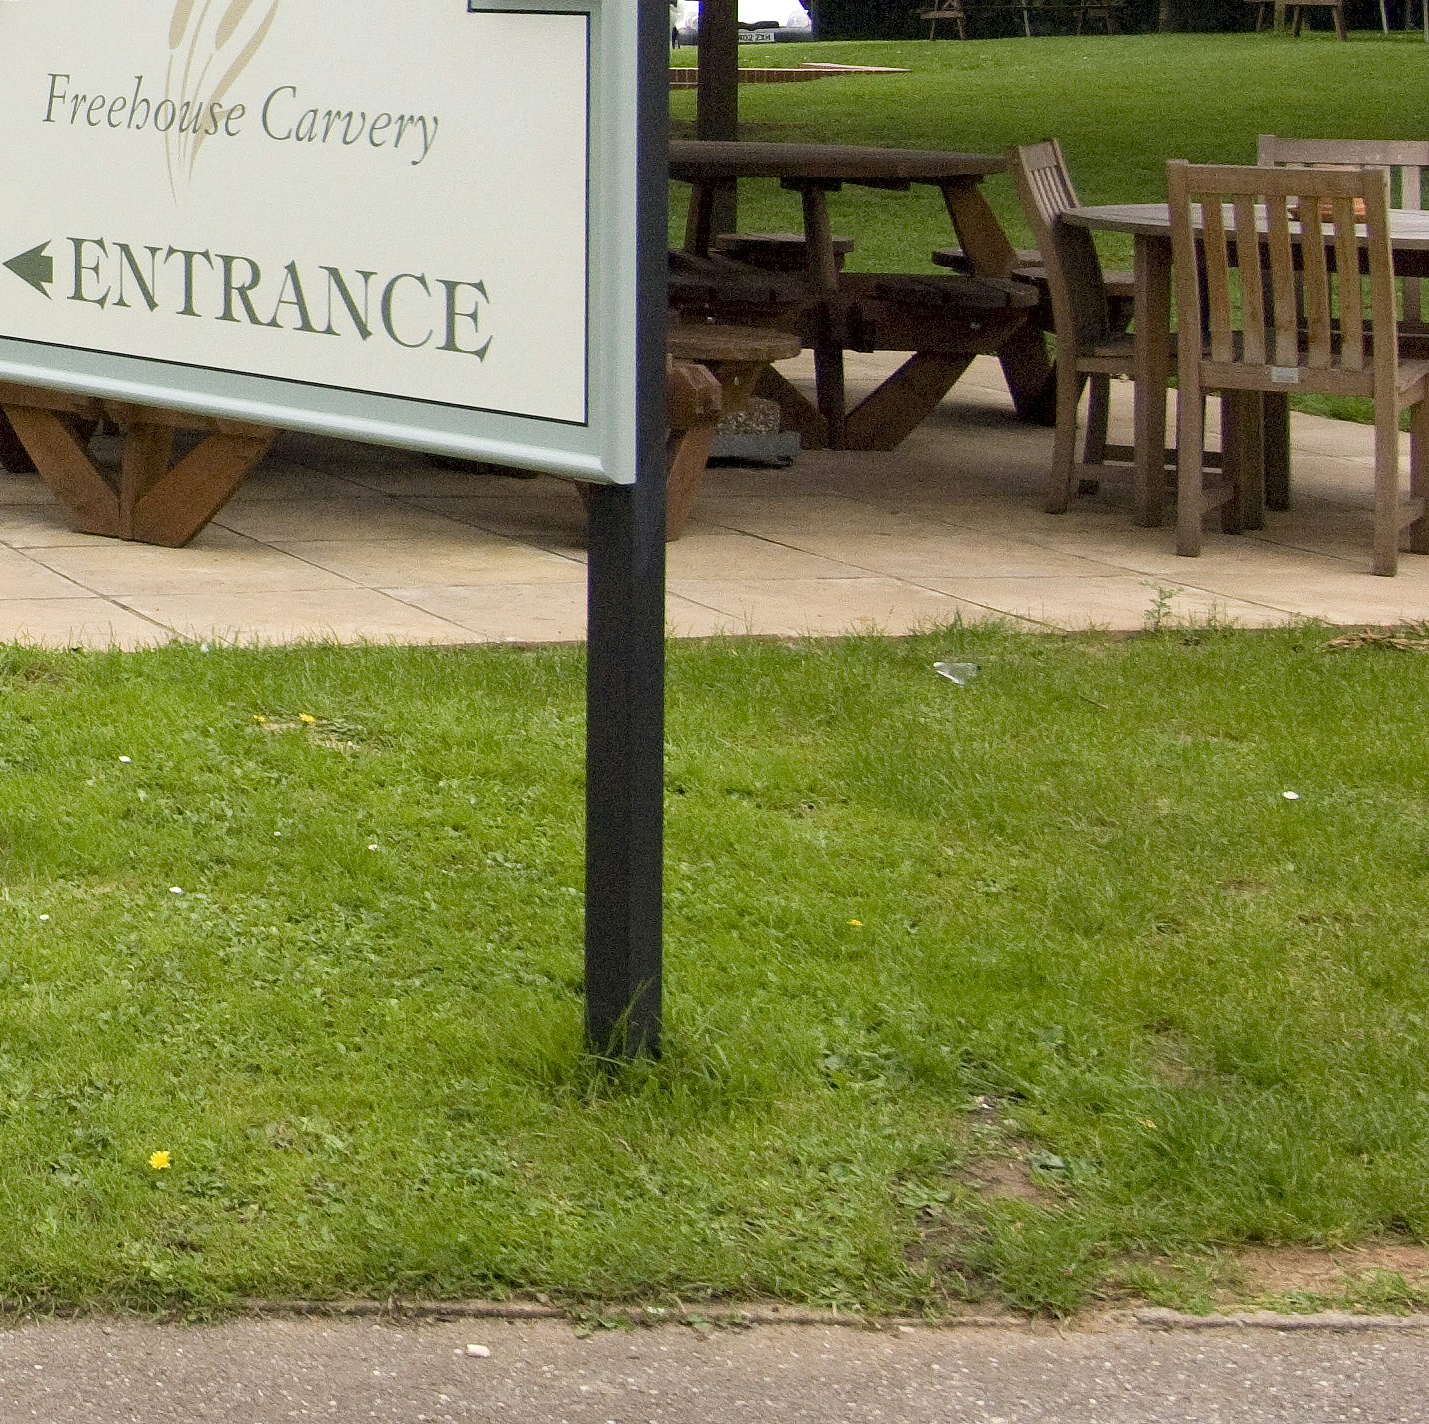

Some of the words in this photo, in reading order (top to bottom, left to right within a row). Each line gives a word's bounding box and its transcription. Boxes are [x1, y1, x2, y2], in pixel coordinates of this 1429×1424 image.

[42, 73, 246, 137] Freehouse
[261, 85, 438, 166] Carvery
[66, 237, 494, 362] ENTRANCE
